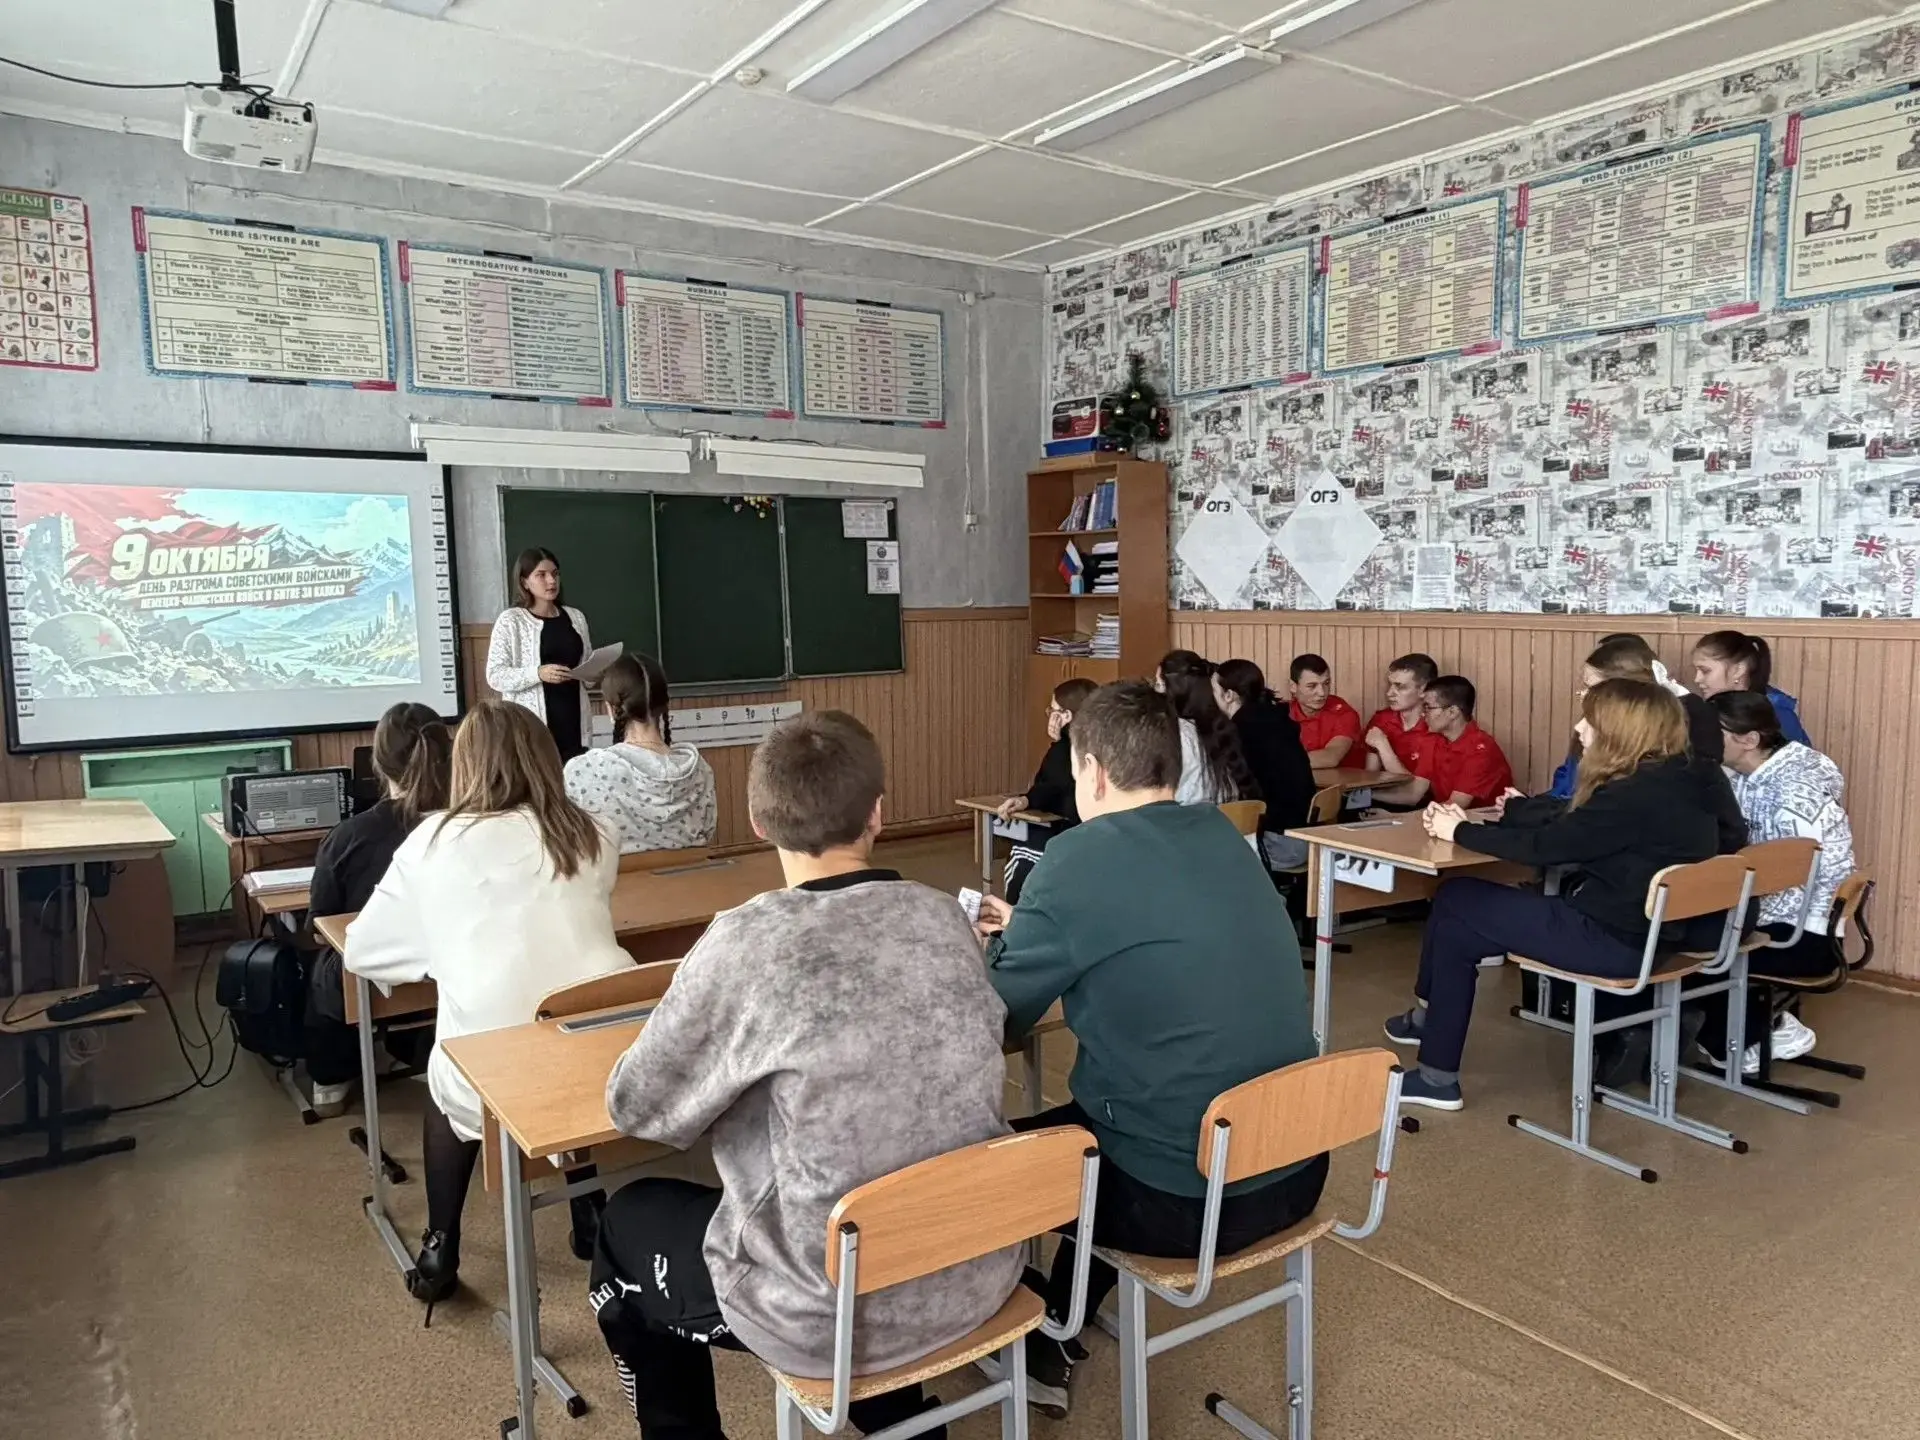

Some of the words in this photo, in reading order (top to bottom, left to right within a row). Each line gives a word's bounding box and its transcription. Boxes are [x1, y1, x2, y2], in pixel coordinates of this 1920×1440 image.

[1678, 150, 1692, 162] (2)
[54, 199, 64, 210] B
[21, 219, 30, 231] E
[56, 223, 64, 234] F
[208, 227, 244, 239] THERE
[300, 238, 321, 248] ARE
[26, 243, 30, 255] I
[60, 248, 68, 259] J
[24, 267, 38, 280] M
[60, 271, 70, 283] N
[522, 266, 568, 279] PRONOUNS
[26, 291, 38, 304] Q
[687, 286, 728, 298] NUMERALS
[62, 295, 72, 308] R
[28, 316, 39, 328] U
[64, 320, 74, 331] V
[30, 340, 40, 352] Y
[65, 343, 74, 355] Z
[1764, 467, 1824, 482] LONDON
[1620, 479, 1672, 492] LONDON
[1311, 490, 1339, 503] ОГЭ
[1206, 501, 1230, 512] ОГЭ
[110, 533, 149, 580] 9
[148, 544, 271, 576] ОКТЯБРЯ
[139, 579, 166, 595] ДЕНЬ
[170, 576, 223, 592] РАЗГРОМА
[226, 571, 293, 591] СОВЕТСКИМИ
[296, 566, 351, 583] ВОЙСКАМИ
[696, 711, 701, 720] 8
[721, 710, 728, 720] 9
